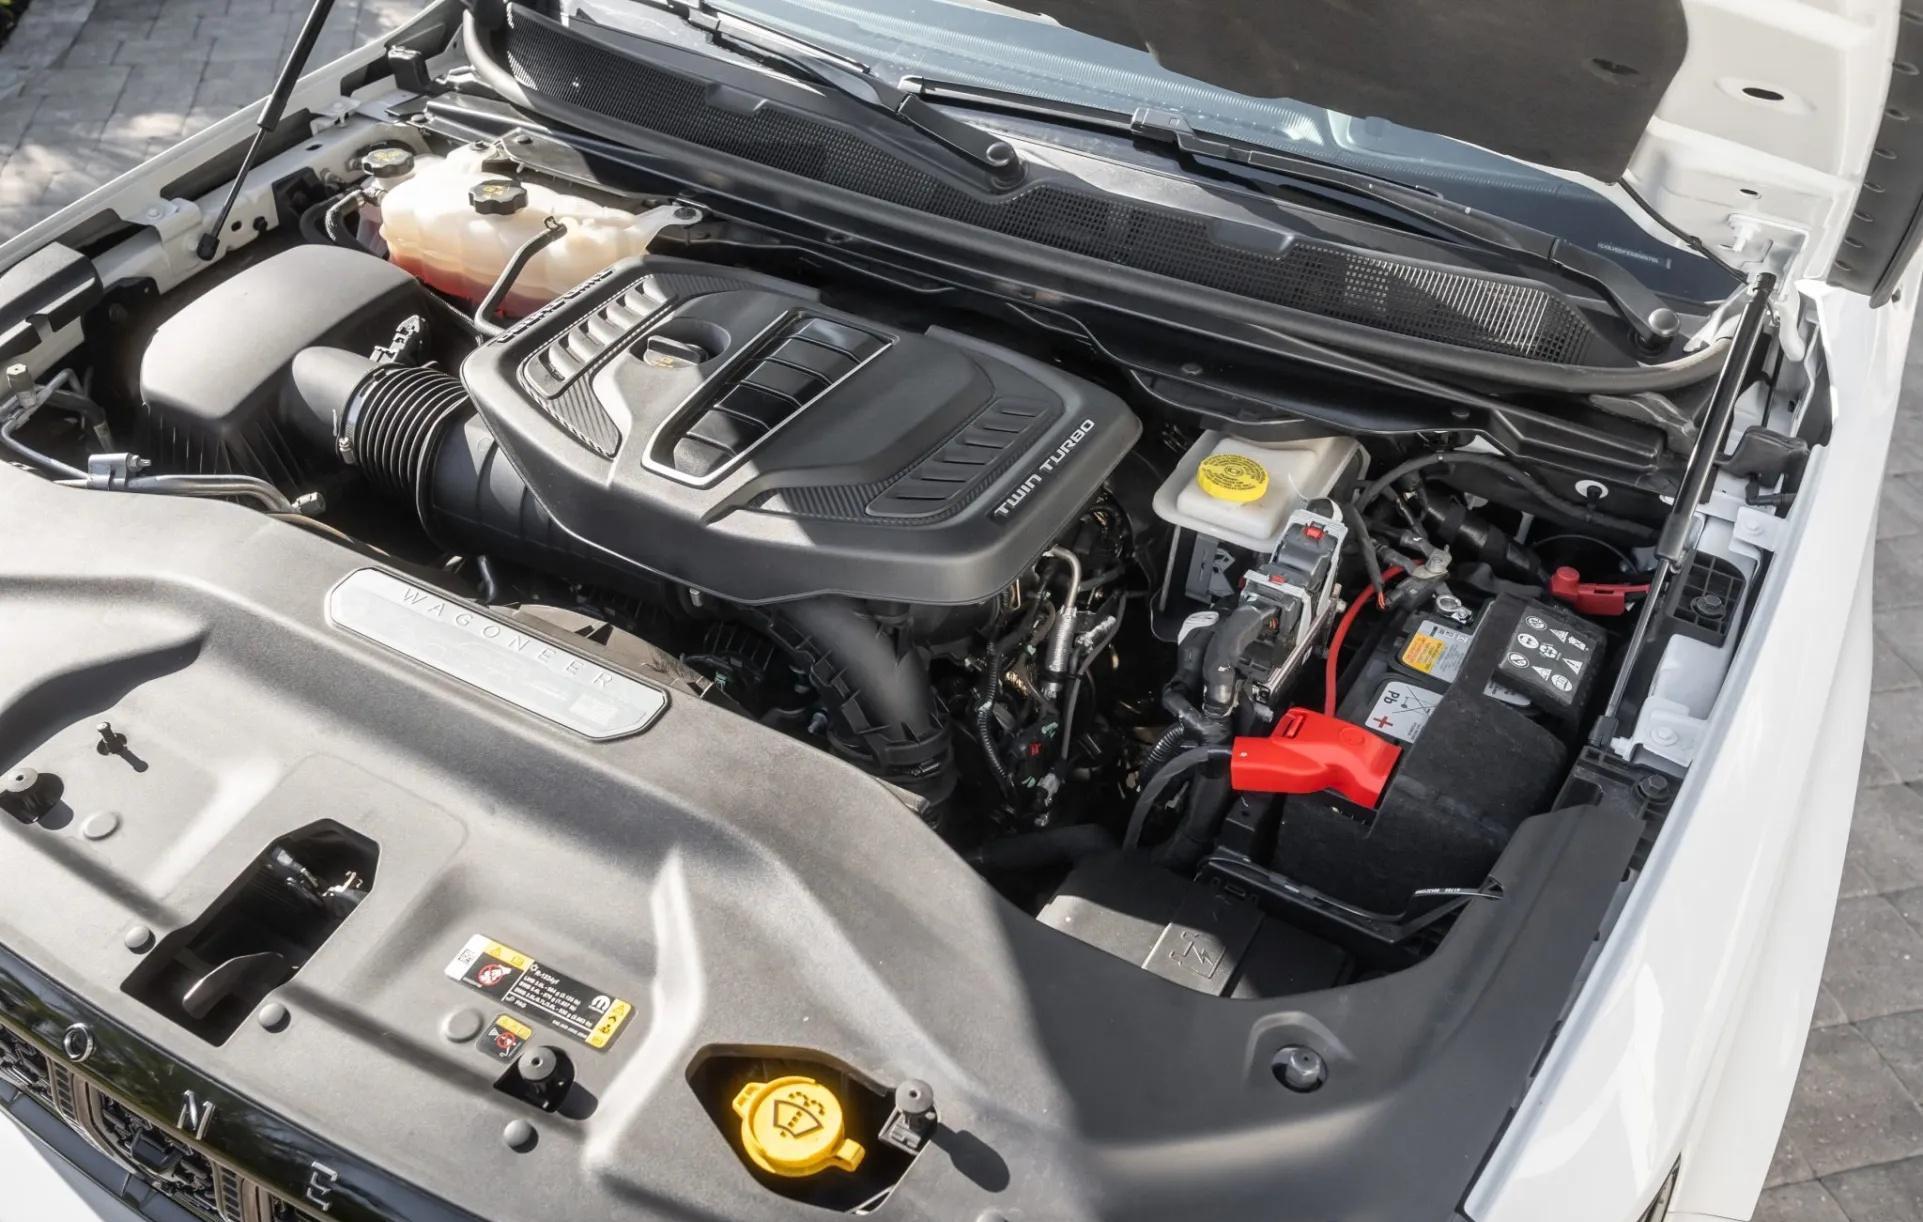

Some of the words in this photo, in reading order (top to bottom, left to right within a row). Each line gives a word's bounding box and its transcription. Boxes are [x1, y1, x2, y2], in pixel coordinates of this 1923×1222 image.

[994, 473, 1042, 515] TWIN
[1039, 418, 1095, 471] TURBO
[401, 587, 613, 688] WAGONEER
[1383, 690, 1400, 704] Pb
